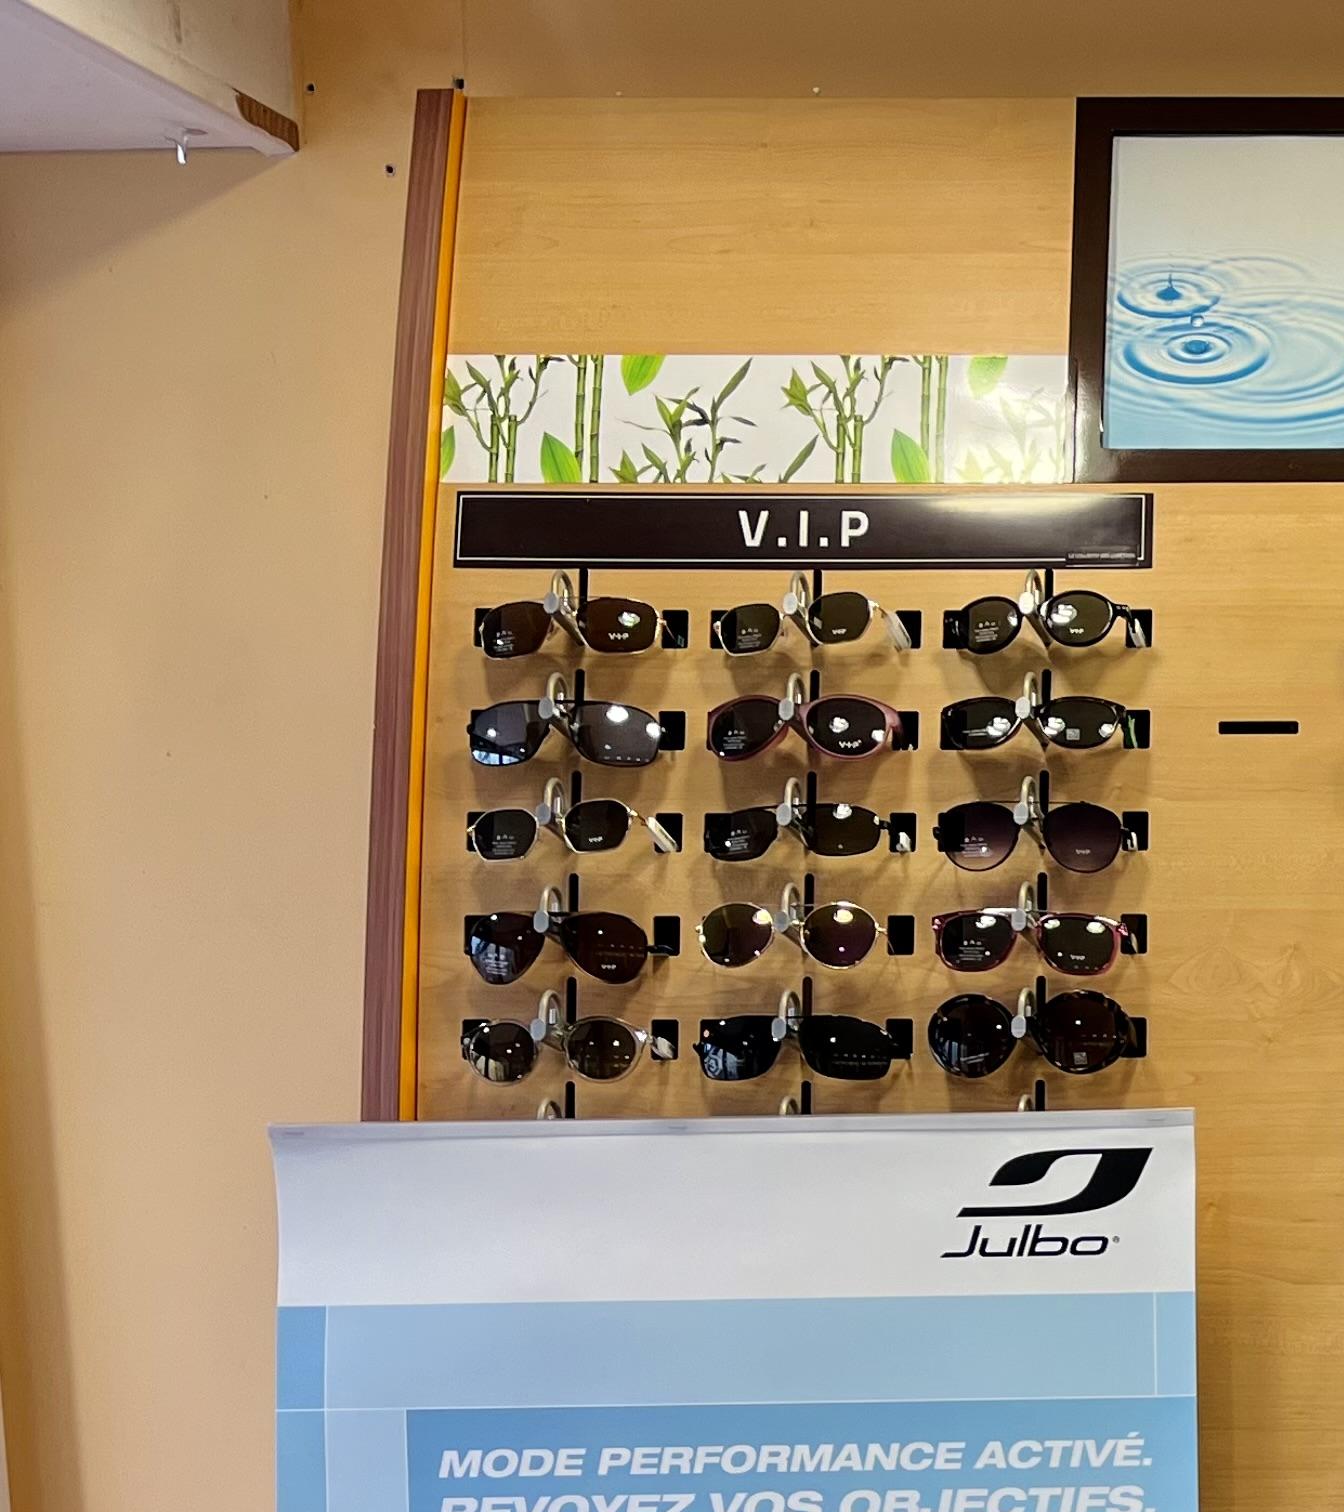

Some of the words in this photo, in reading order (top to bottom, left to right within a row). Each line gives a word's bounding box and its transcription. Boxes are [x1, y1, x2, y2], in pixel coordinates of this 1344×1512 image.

[737, 510, 870, 548] V.I.P
[438, 1447, 587, 1478] MODE
[598, 1441, 966, 1476] PERFORMANCE
[973, 1432, 1153, 1470] ACTIVÉ.
